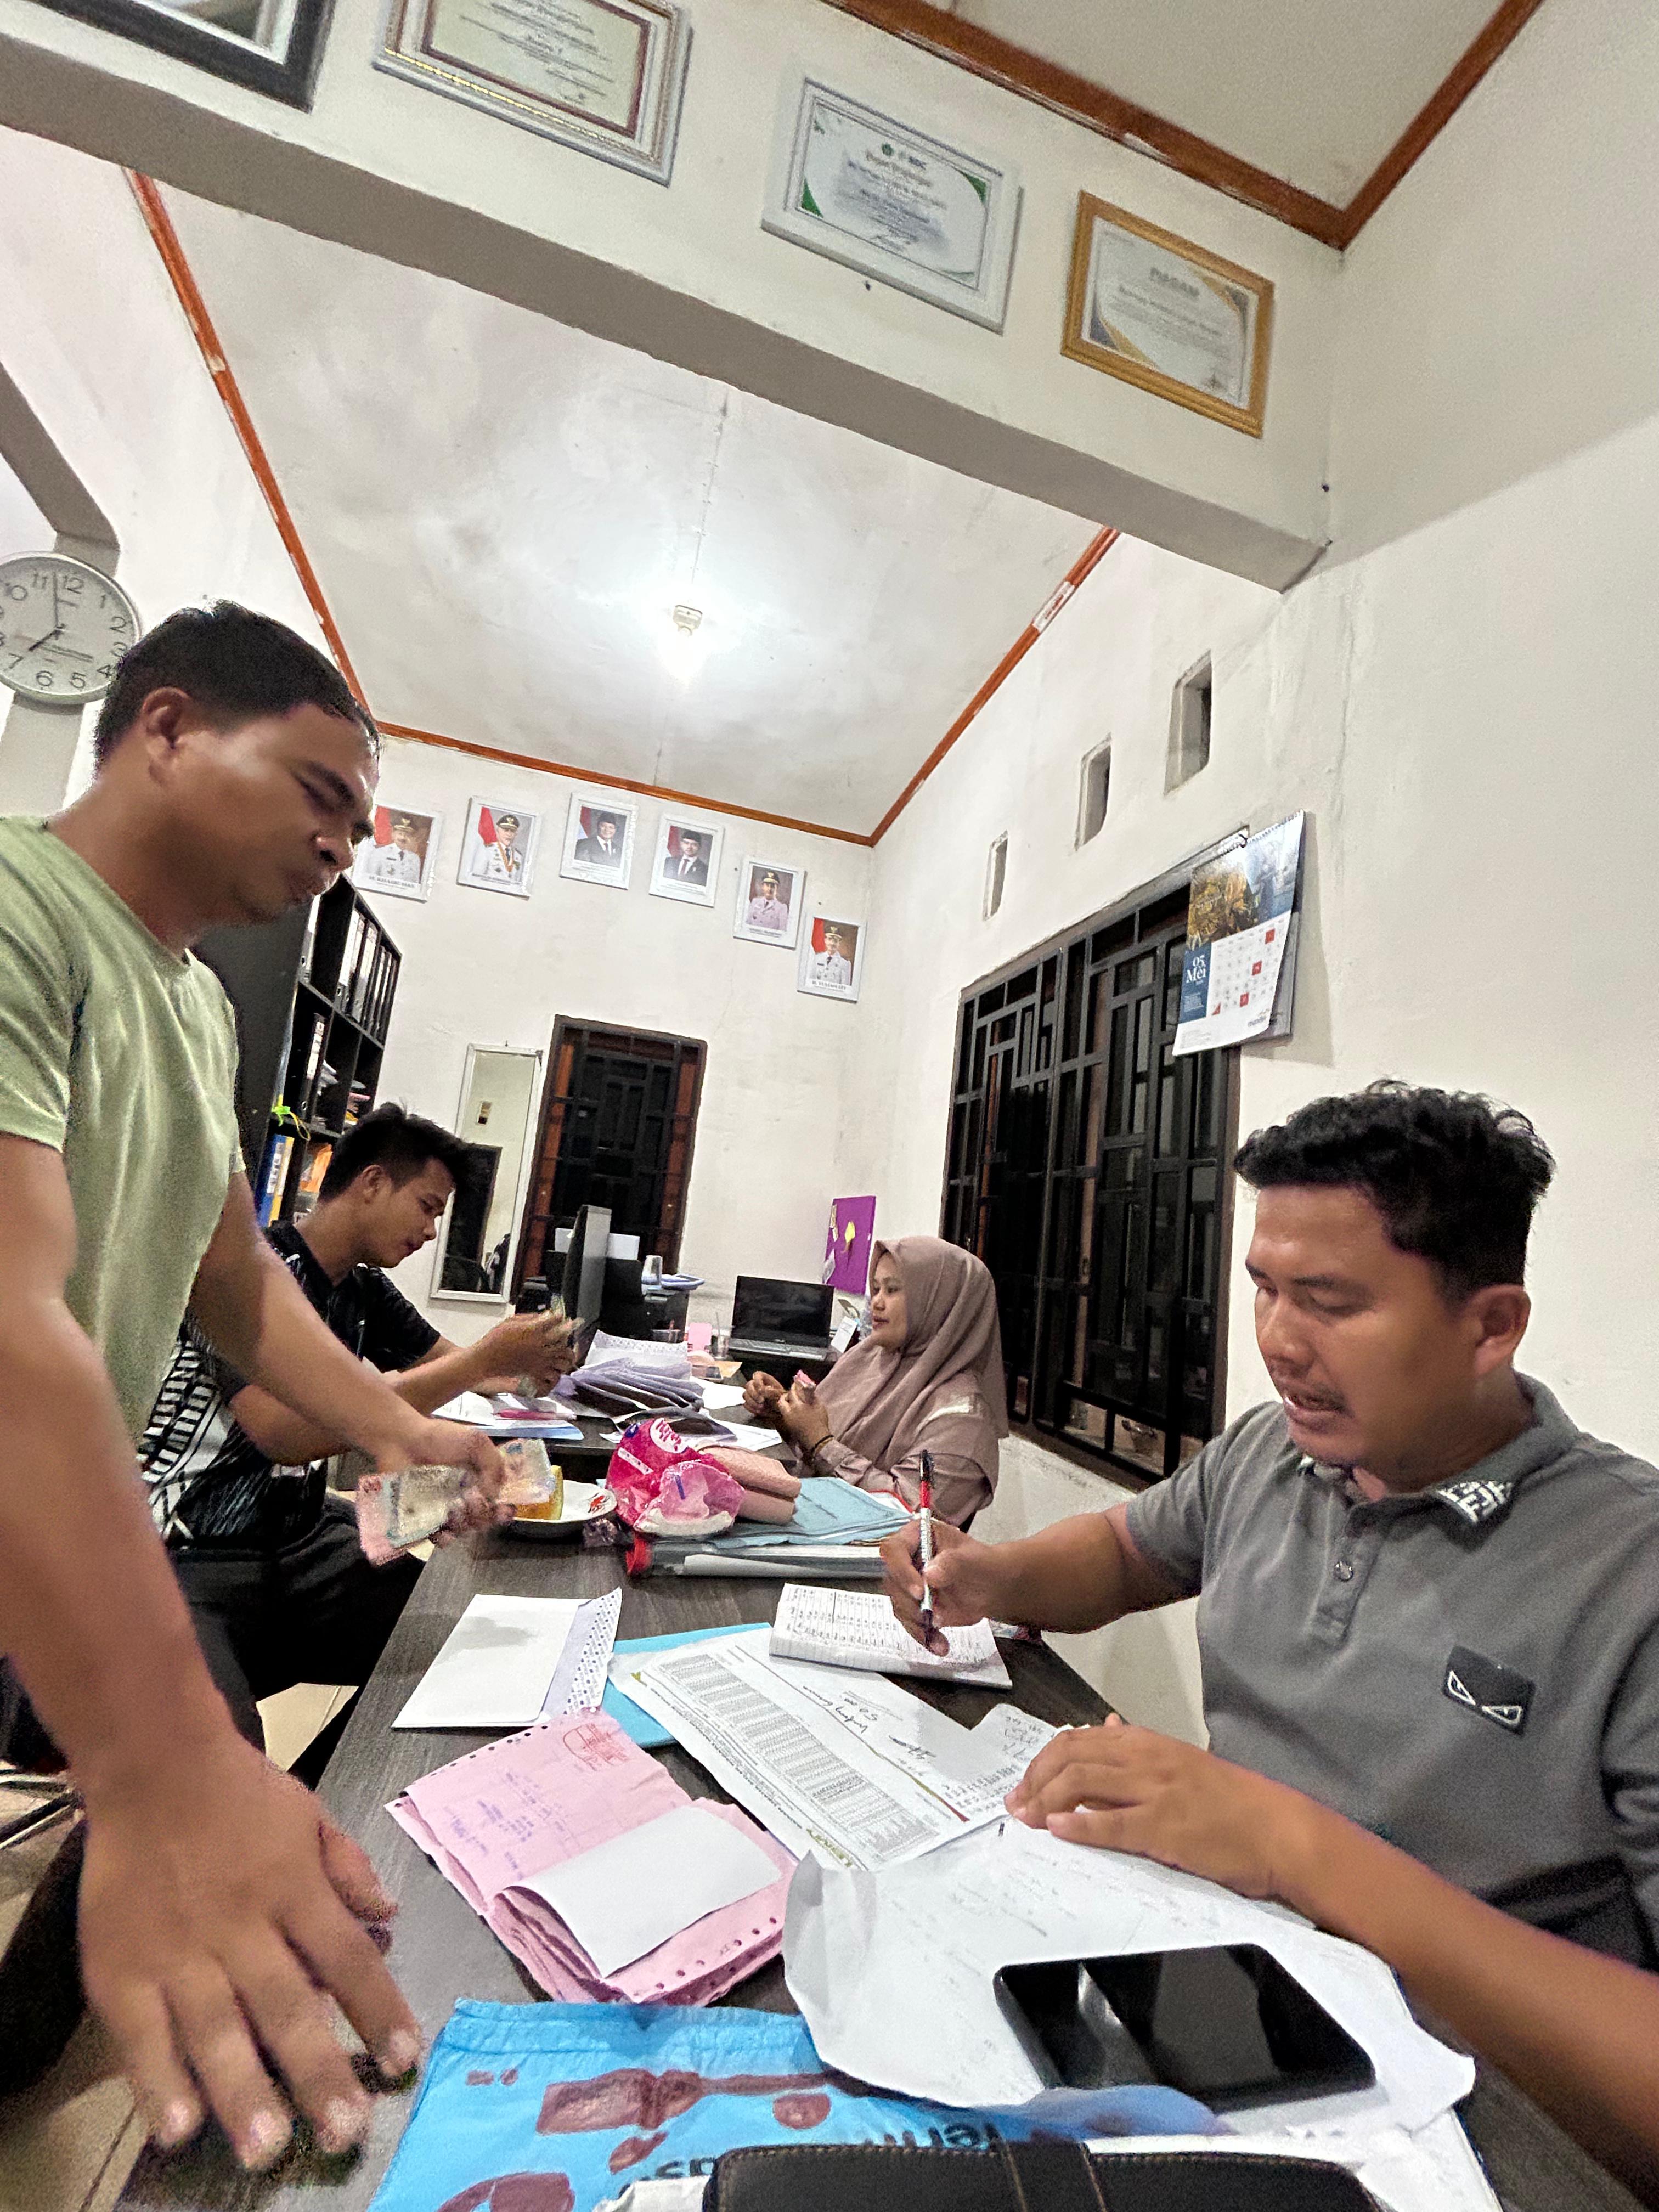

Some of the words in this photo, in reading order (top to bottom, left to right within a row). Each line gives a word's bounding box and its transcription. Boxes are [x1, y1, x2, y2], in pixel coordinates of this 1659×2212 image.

[32, 570, 48, 589] 11
[63, 575, 84, 594] 12
[100, 594, 106, 609] 1
[110, 616, 126, 633] 2
[8, 653, 24, 669] 7
[36, 670, 53, 687] 6
[69, 672, 86, 689] 5
